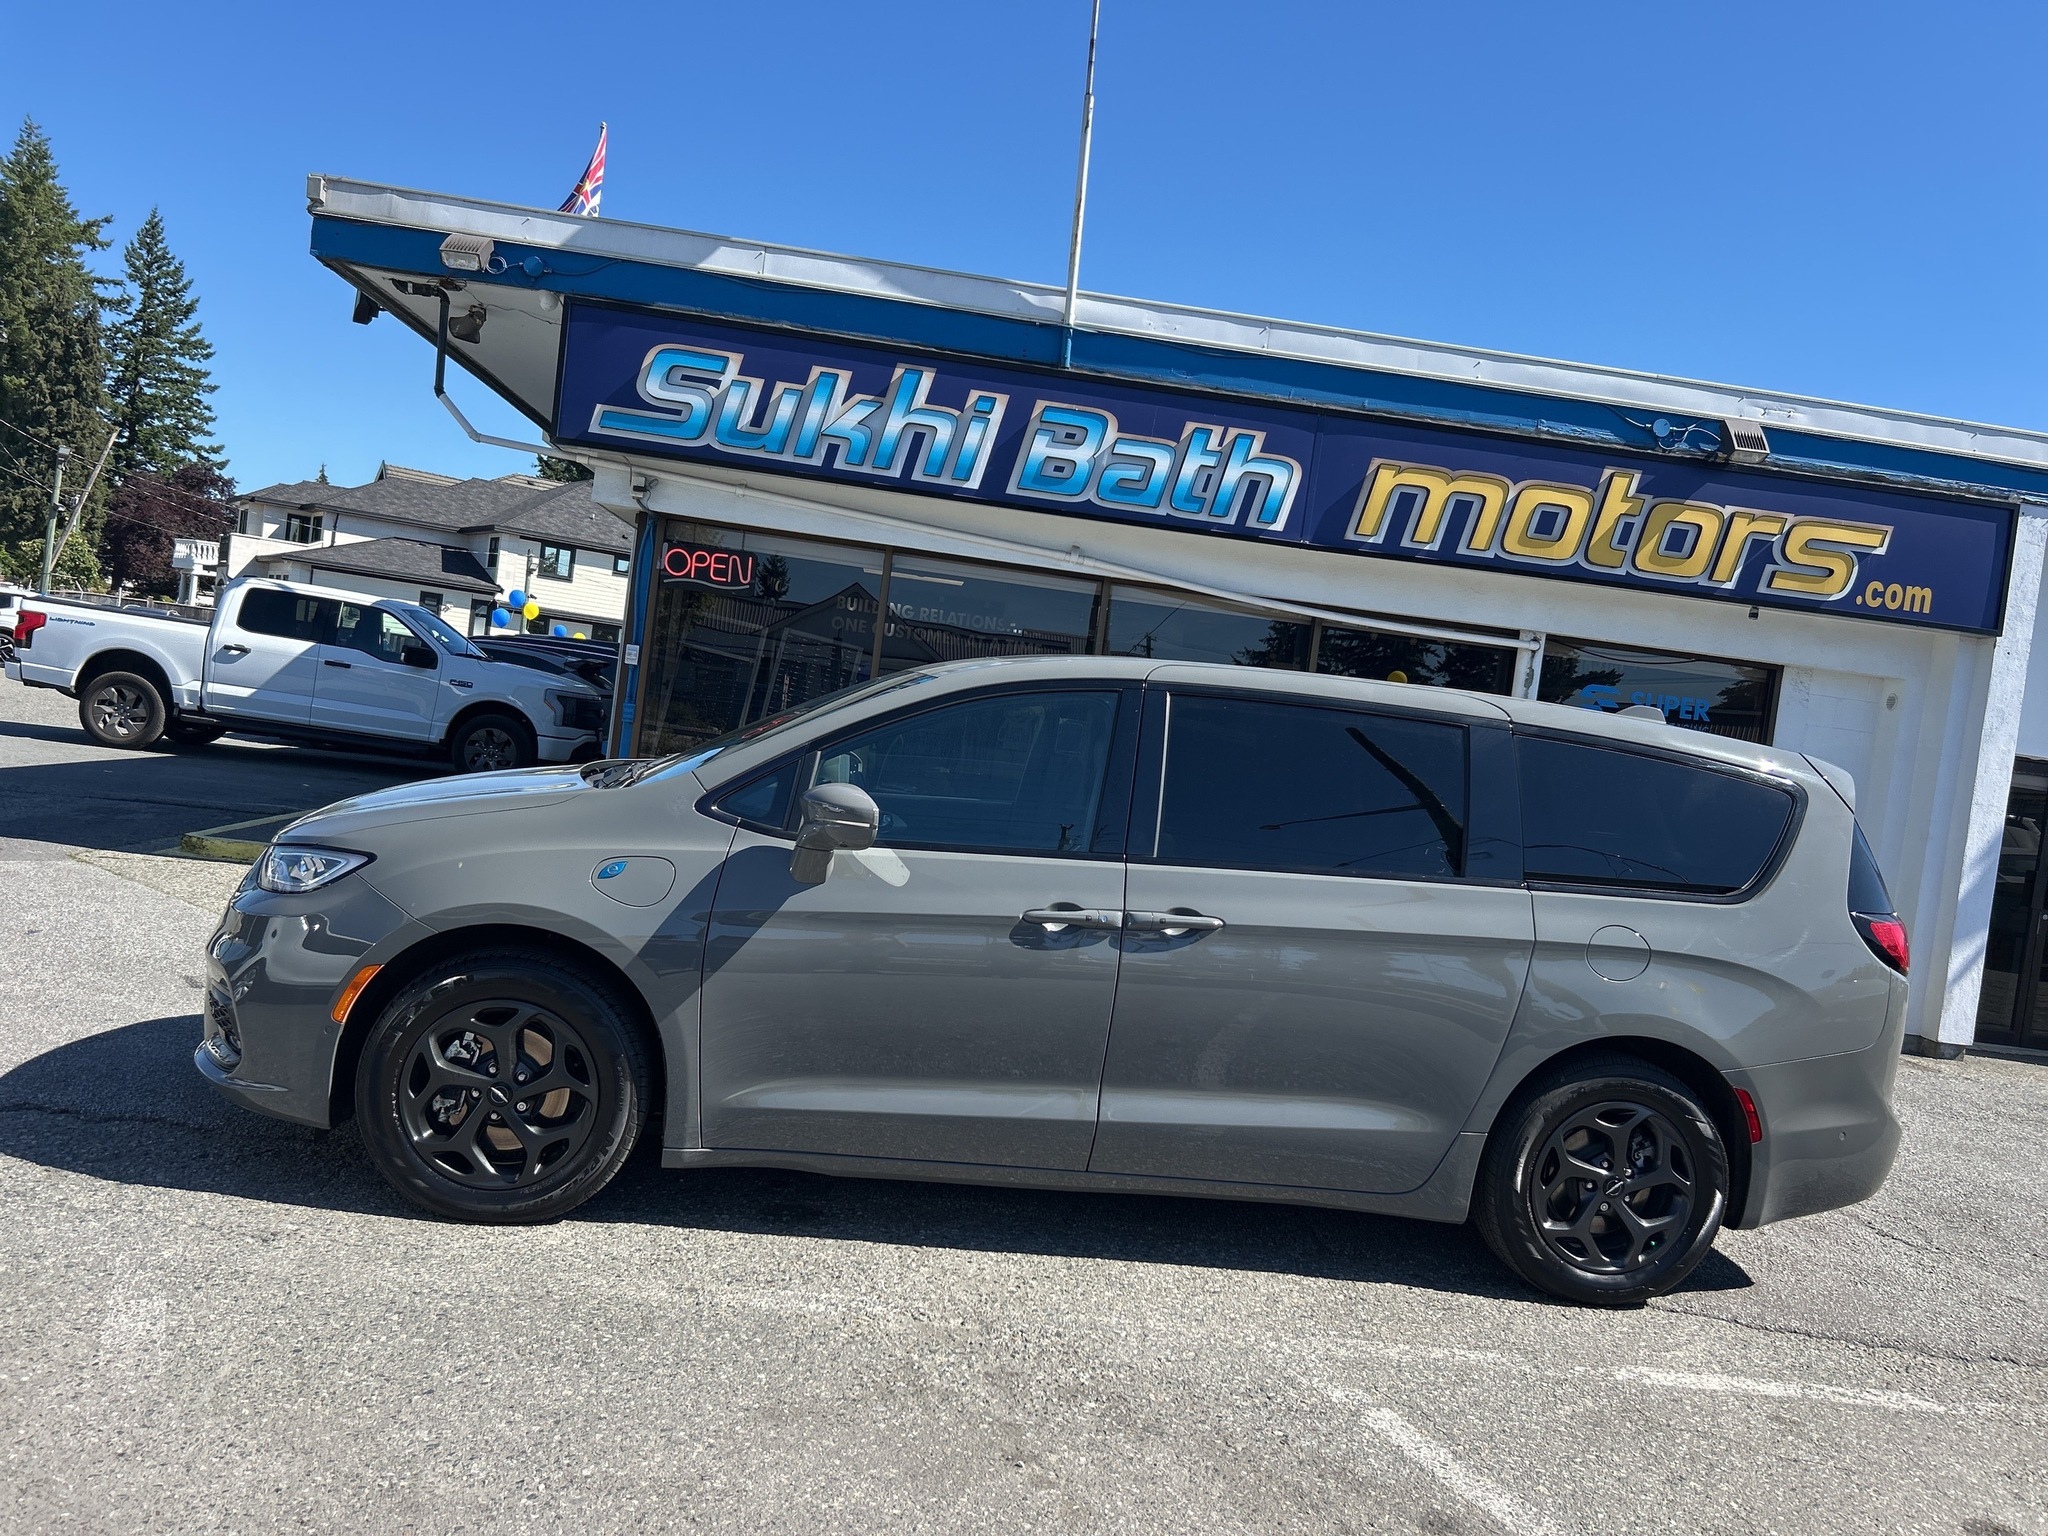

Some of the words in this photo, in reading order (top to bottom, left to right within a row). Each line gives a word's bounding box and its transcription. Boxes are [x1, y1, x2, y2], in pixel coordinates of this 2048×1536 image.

[589, 343, 1010, 490] Sukhi
[1006, 399, 1302, 531] Bath
[1344, 457, 1893, 603] motors
[1855, 581, 1932, 614] .com
[664, 548, 752, 584] OPEN
[836, 595, 915, 619] BUILDNG
